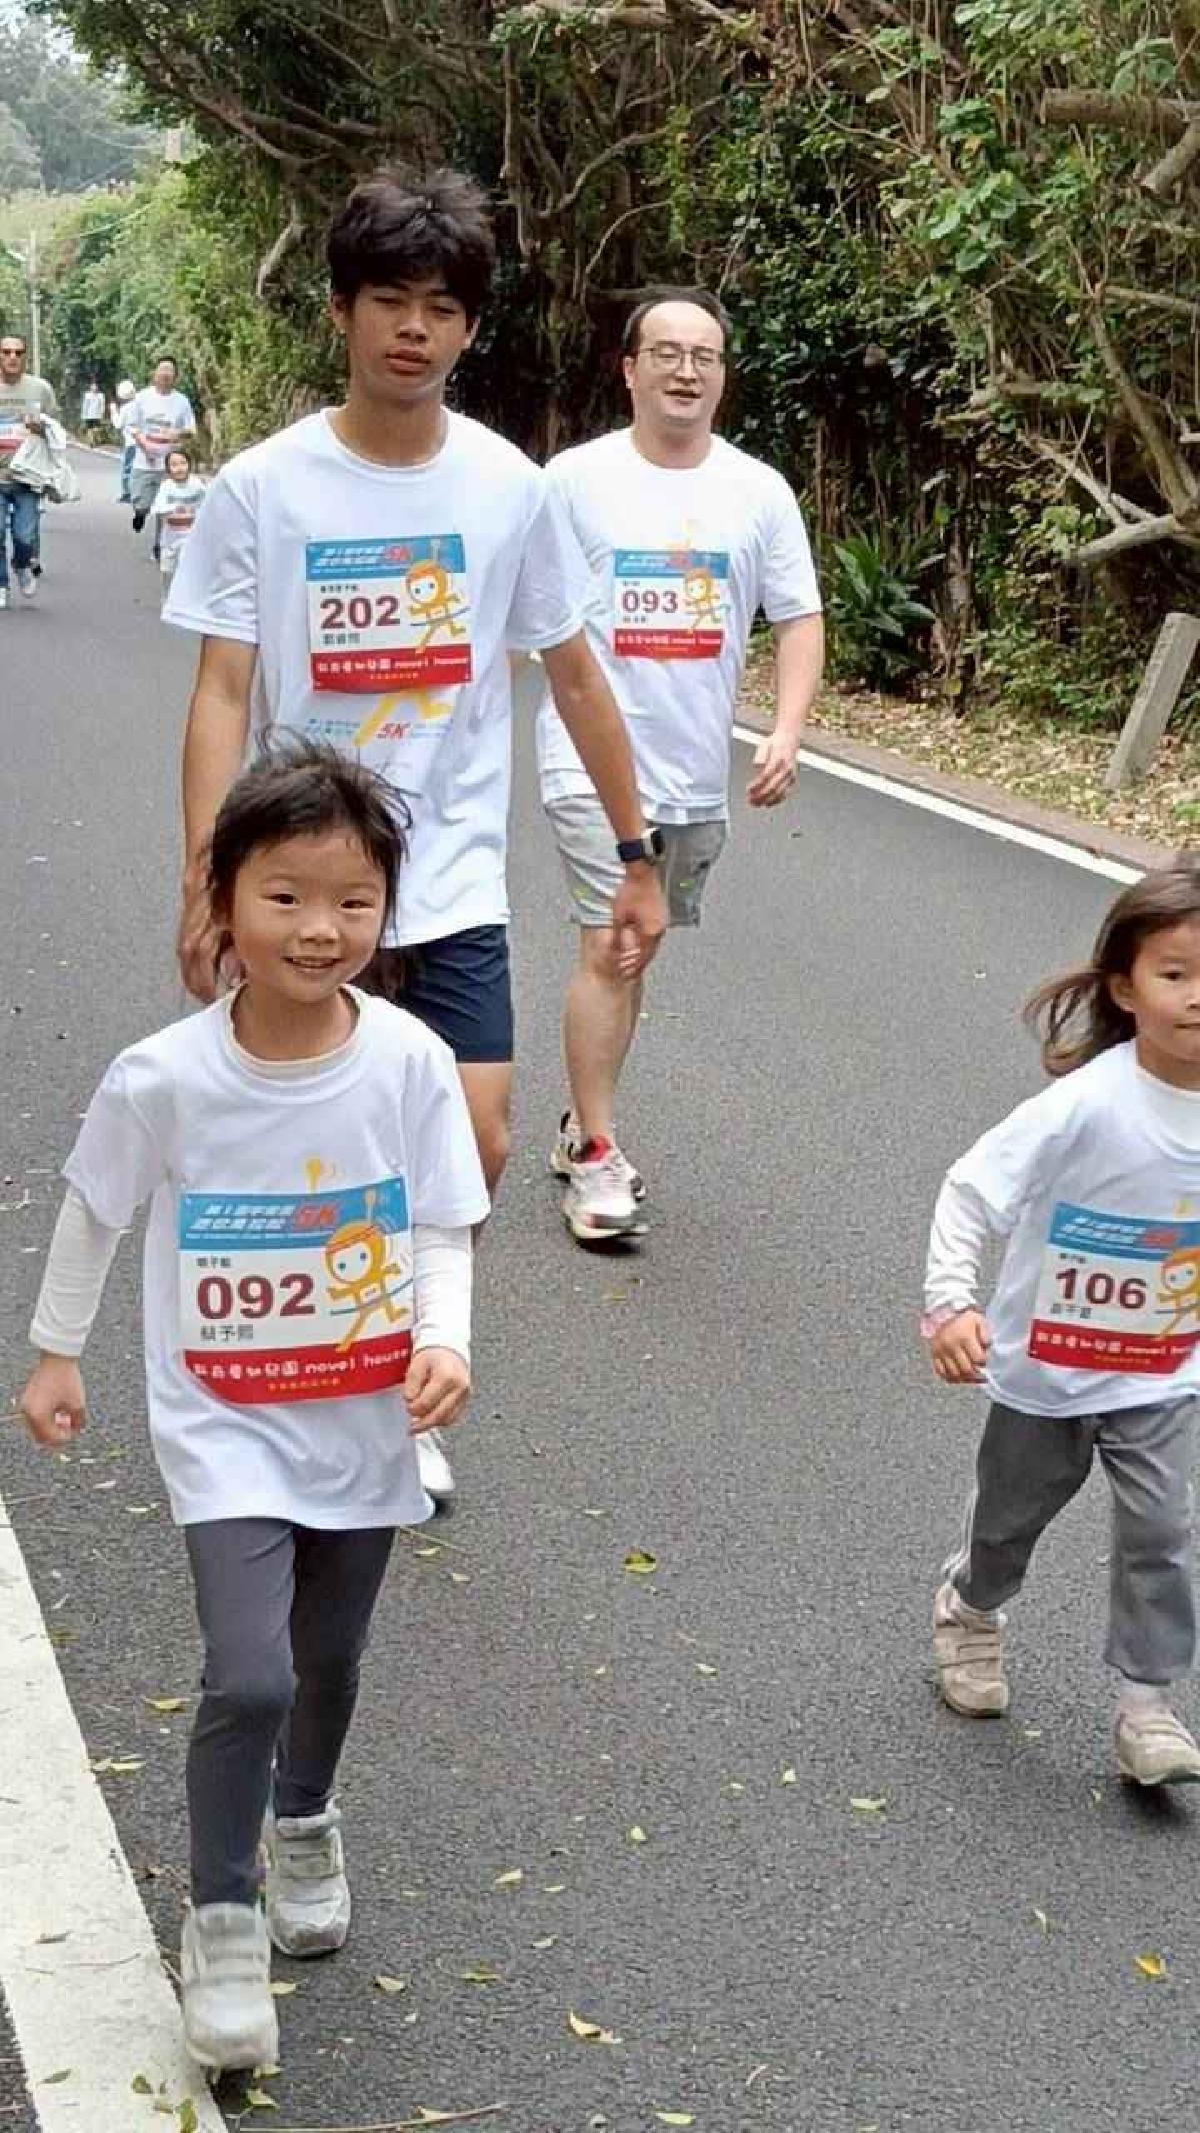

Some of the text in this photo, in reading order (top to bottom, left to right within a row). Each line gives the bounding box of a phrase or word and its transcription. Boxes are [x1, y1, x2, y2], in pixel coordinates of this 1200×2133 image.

[319, 595, 401, 630] 202
[622, 589, 679, 614] 093
[196, 1272, 317, 1320] 092
[1055, 1267, 1148, 1310] 106
[304, 1356, 357, 1376] novel
